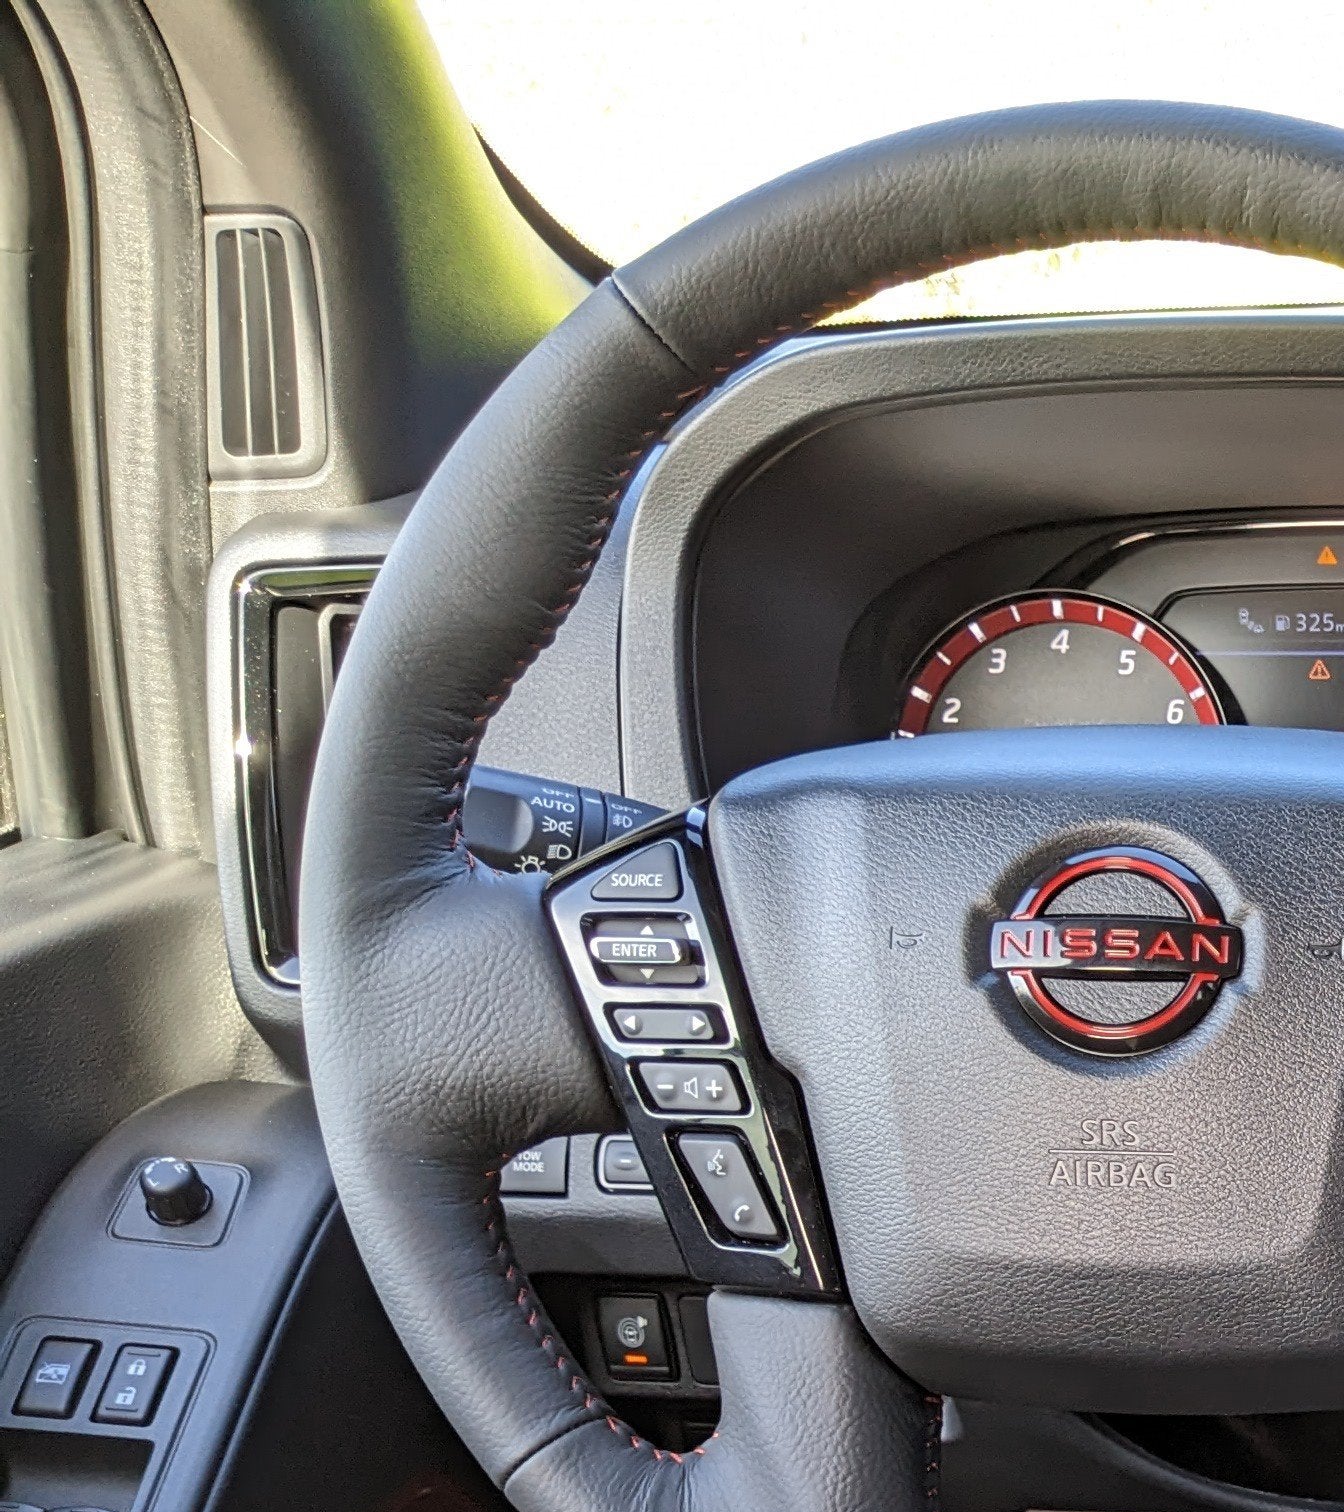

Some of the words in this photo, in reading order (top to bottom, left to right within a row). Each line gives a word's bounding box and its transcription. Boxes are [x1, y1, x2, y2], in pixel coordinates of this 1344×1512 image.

[1050, 629, 1070, 654] 4
[988, 649, 1007, 674] 3
[1118, 650, 1136, 675] 5
[942, 698, 961, 723] 2
[1166, 700, 1185, 724] 6
[531, 797, 575, 813] AUTO
[611, 873, 663, 887] SOURCE
[611, 943, 657, 958] ENTER
[1000, 927, 1229, 963] NISSAN
[1081, 1119, 1139, 1146] SRS
[513, 1161, 544, 1172] MODE
[1050, 1160, 1175, 1188] AIRBAG
